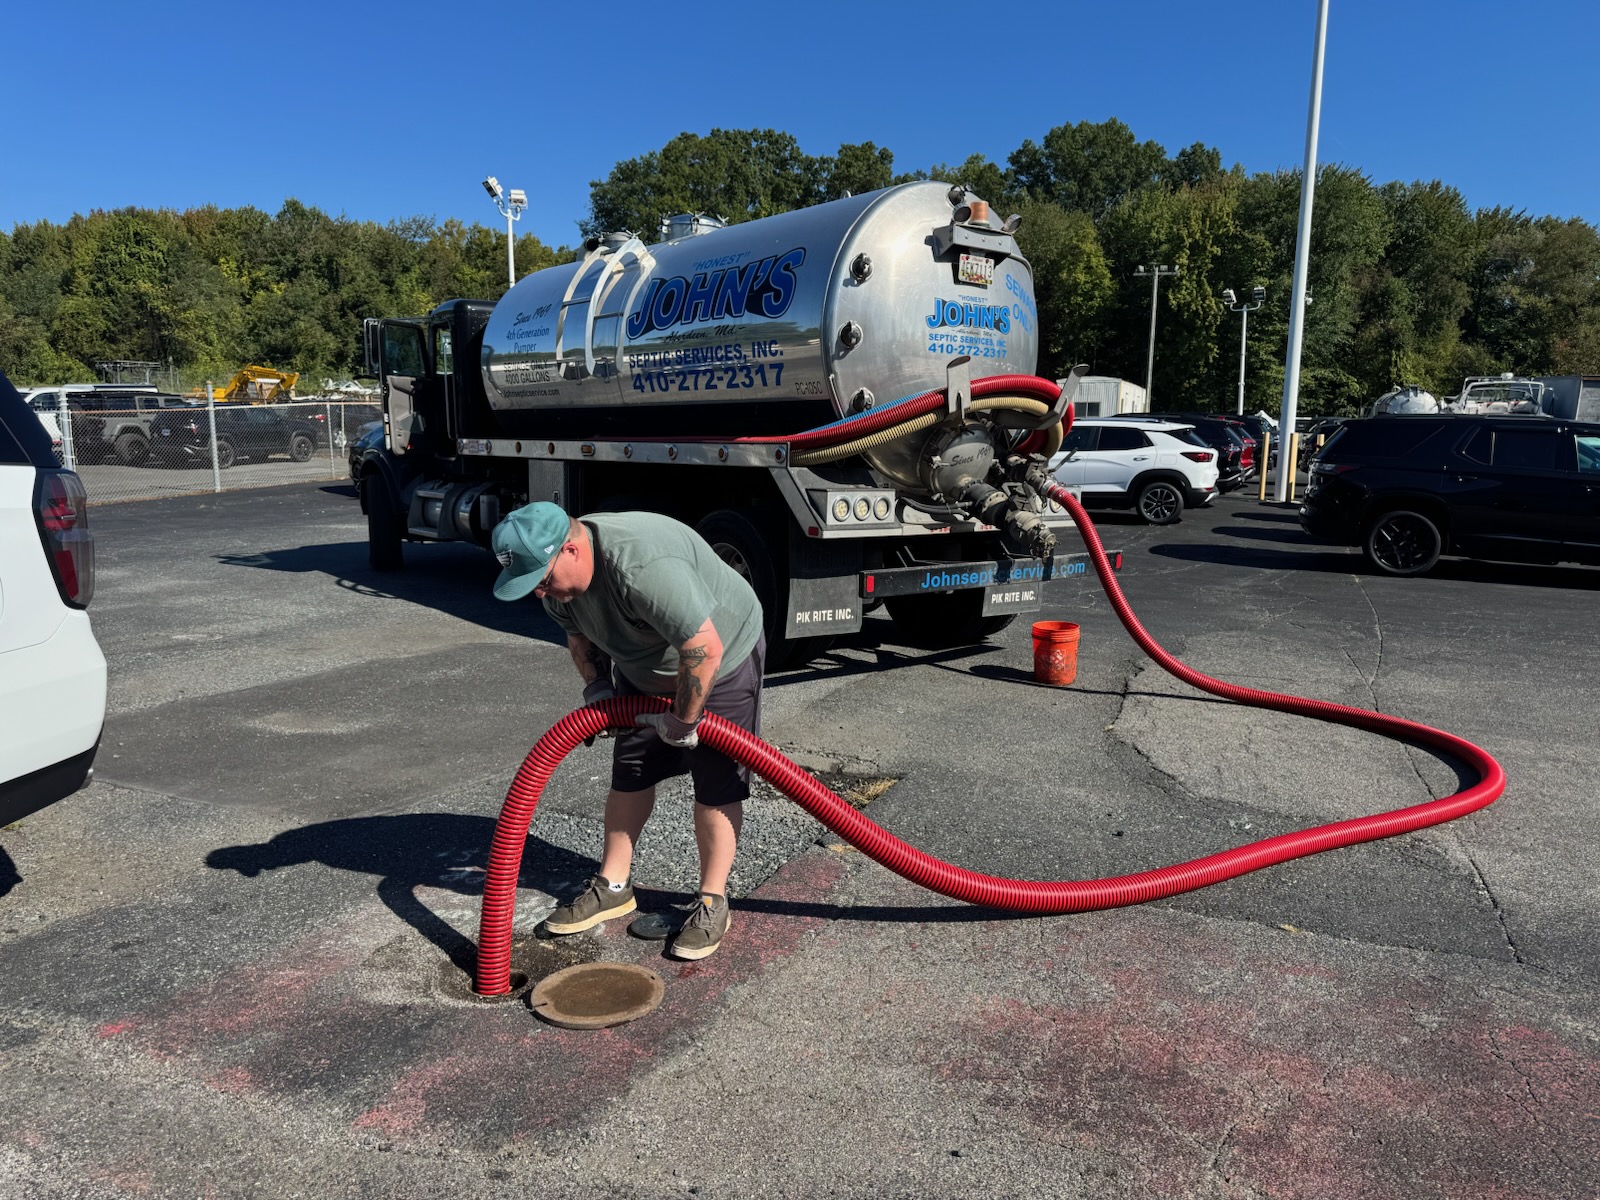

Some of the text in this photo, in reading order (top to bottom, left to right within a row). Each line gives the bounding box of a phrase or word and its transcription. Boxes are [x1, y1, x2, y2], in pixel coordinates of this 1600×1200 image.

[626, 247, 806, 340] JOHN'S
[513, 312, 531, 326] Since
[925, 297, 1010, 335] JOHN'S
[506, 326, 550, 341] 4th Generation
[929, 333, 958, 343] SEPTIC
[514, 343, 537, 356] Pumper
[629, 351, 671, 370] SEPTIC
[752, 339, 784, 359] INC.
[928, 343, 1007, 359] 410-272-2317
[503, 359, 548, 373] SEWAGE ONLY
[521, 370, 550, 383] GALLONS
[633, 362, 784, 393] 410-272-2317
[950, 455, 973, 467] Since
[991, 590, 1036, 604] PIK RITE INC.
[796, 607, 854, 624] PIK RITE INC.
